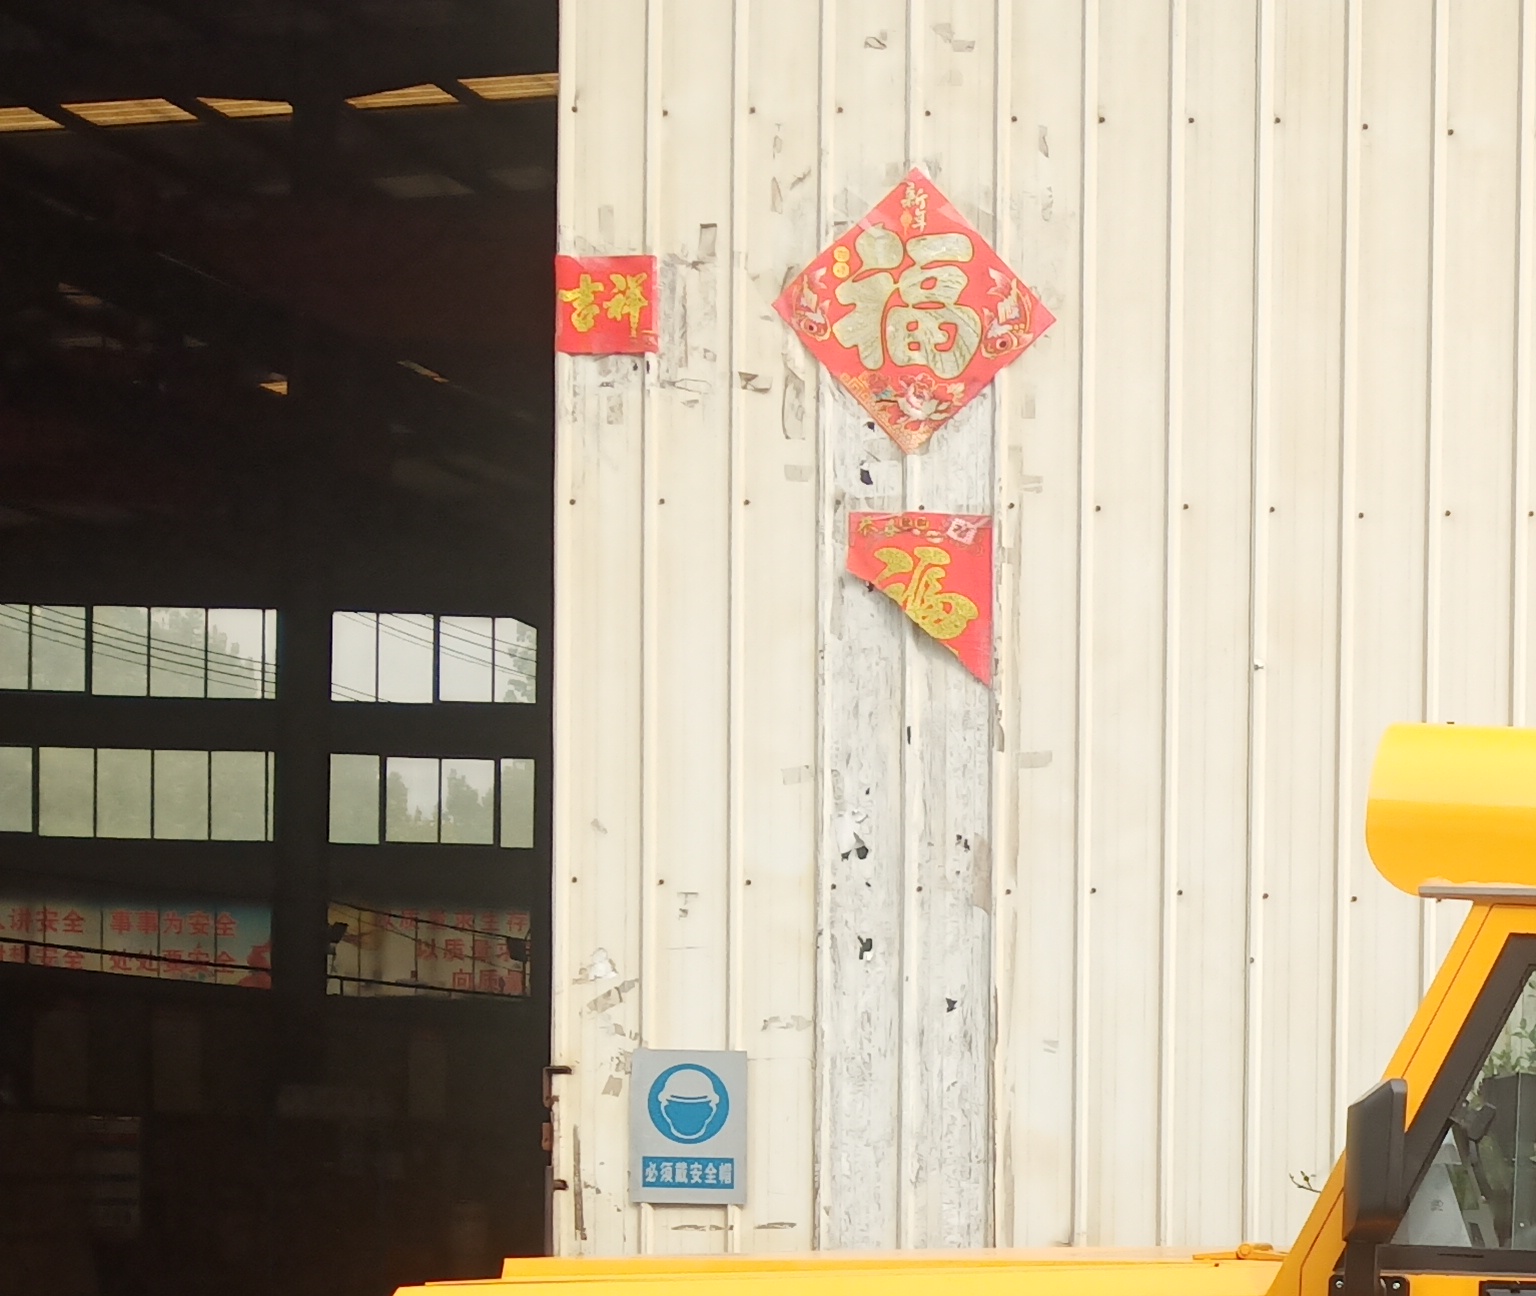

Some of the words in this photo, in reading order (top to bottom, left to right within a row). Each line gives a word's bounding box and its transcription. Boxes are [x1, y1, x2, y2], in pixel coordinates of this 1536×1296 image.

[558, 272, 649, 338] 吉祥
[835, 222, 983, 380] 福
[0, 907, 85, 934] 讲安全
[110, 909, 238, 938] 事事为安全
[645, 1161, 733, 1185] 必须戴安全帽
